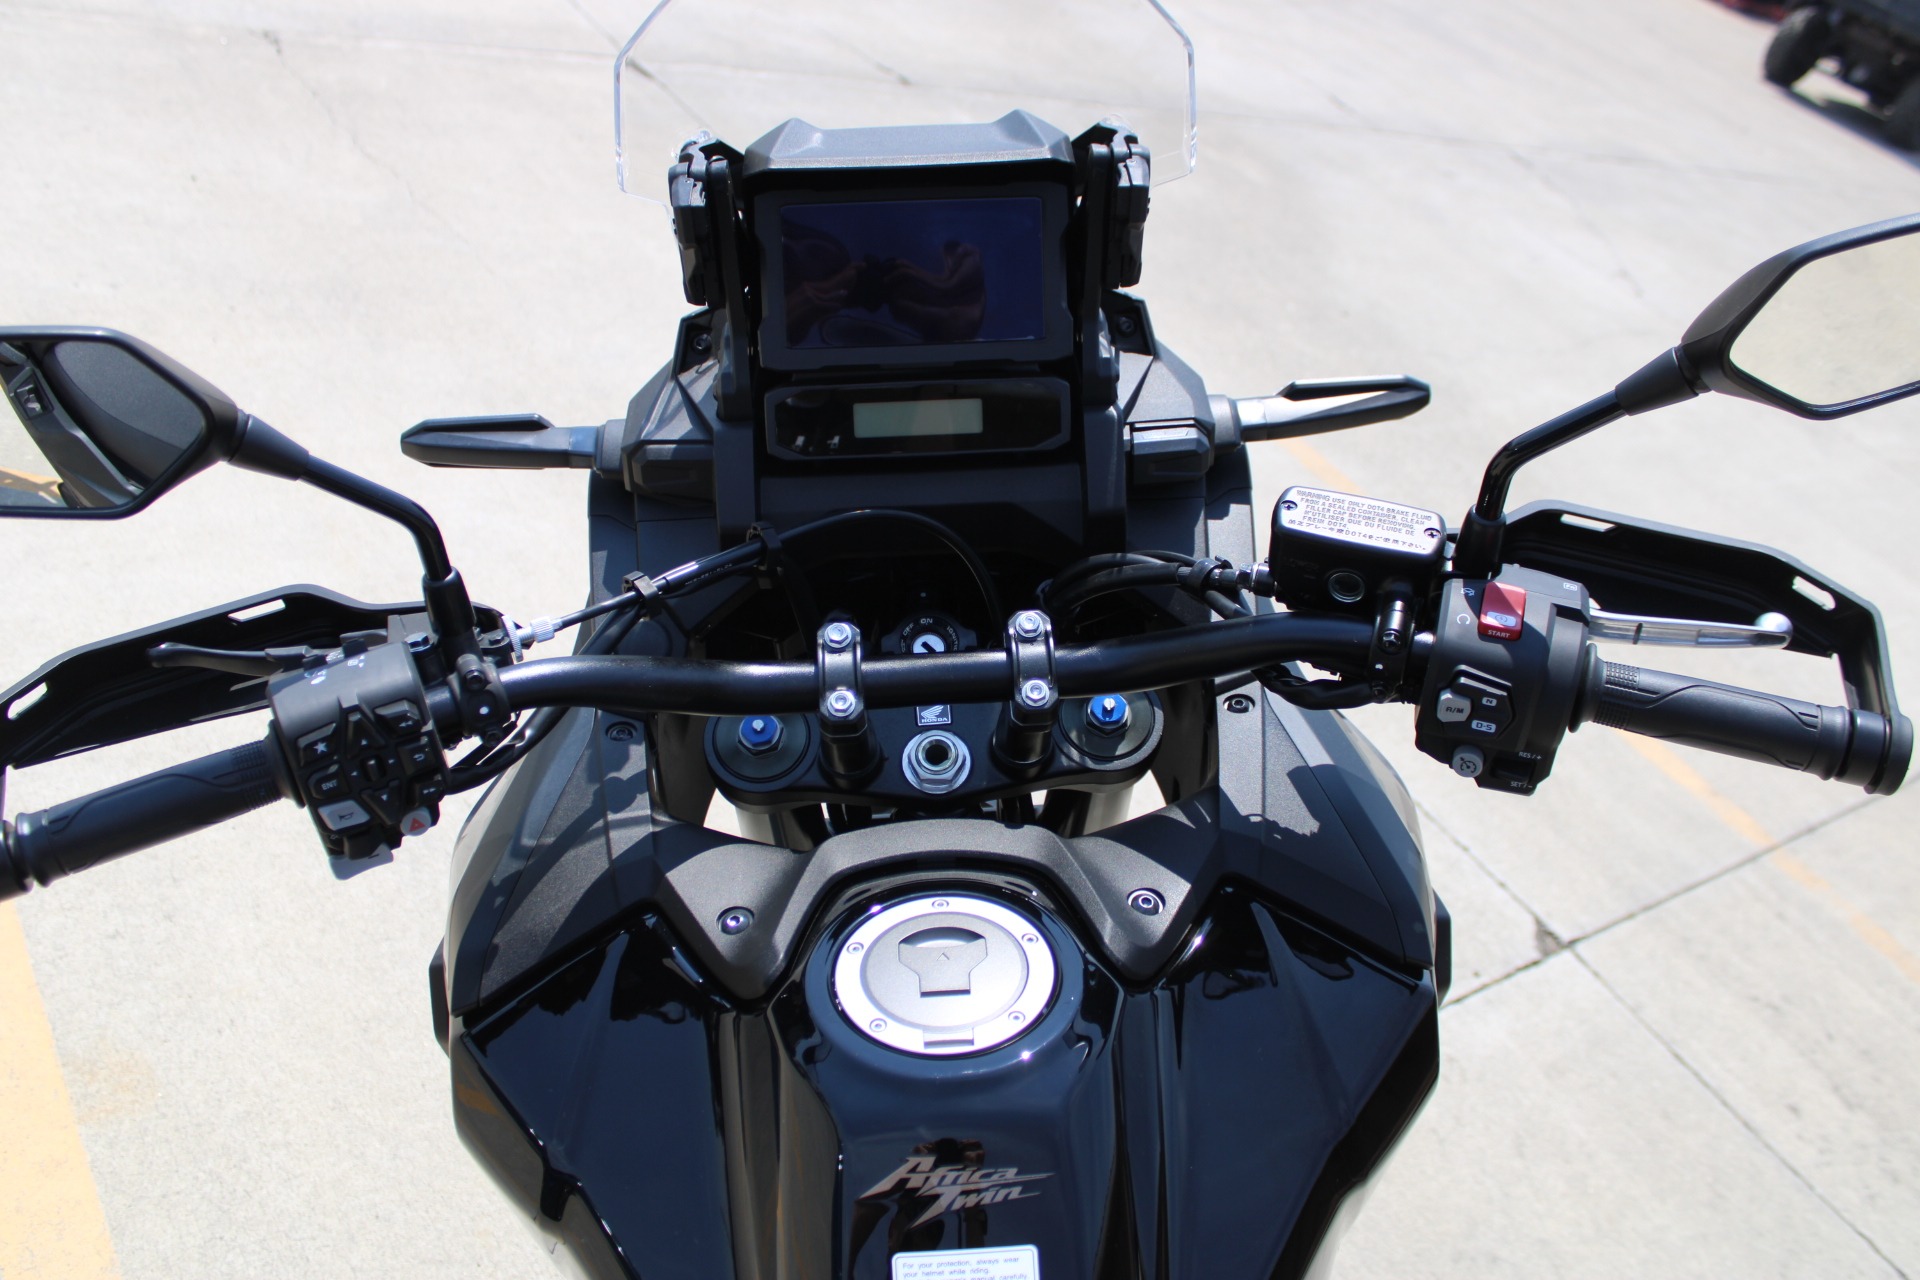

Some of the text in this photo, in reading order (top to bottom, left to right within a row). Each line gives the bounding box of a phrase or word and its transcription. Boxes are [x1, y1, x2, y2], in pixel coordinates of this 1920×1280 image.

[1300, 497, 1320, 506] FROM
[1327, 503, 1356, 513] SEALED
[1401, 517, 1425, 526] CLEAN
[1305, 504, 1332, 514] FILLER
[1348, 512, 1376, 523] BEFORE
[1348, 500, 1366, 508] ONLY
[1367, 504, 1385, 512] DOT4
[1386, 508, 1410, 517] BRAKE
[1411, 512, 1432, 522] FLUID
[1302, 515, 1325, 524] FREIN
[1377, 523, 1403, 534] FLUIDE
[1405, 529, 1416, 537] DE
[902, 622, 915, 636] OFF
[1487, 629, 1511, 638] START
[321, 779, 338, 790] ENT
[859, 1156, 1056, 1199] Africa
[910, 1184, 1041, 1229] Twin
[917, 1262, 933, 1270] your
[936, 1259, 972, 1269] protection,
[976, 1257, 999, 1266] always
[922, 1268, 945, 1276] helmet
